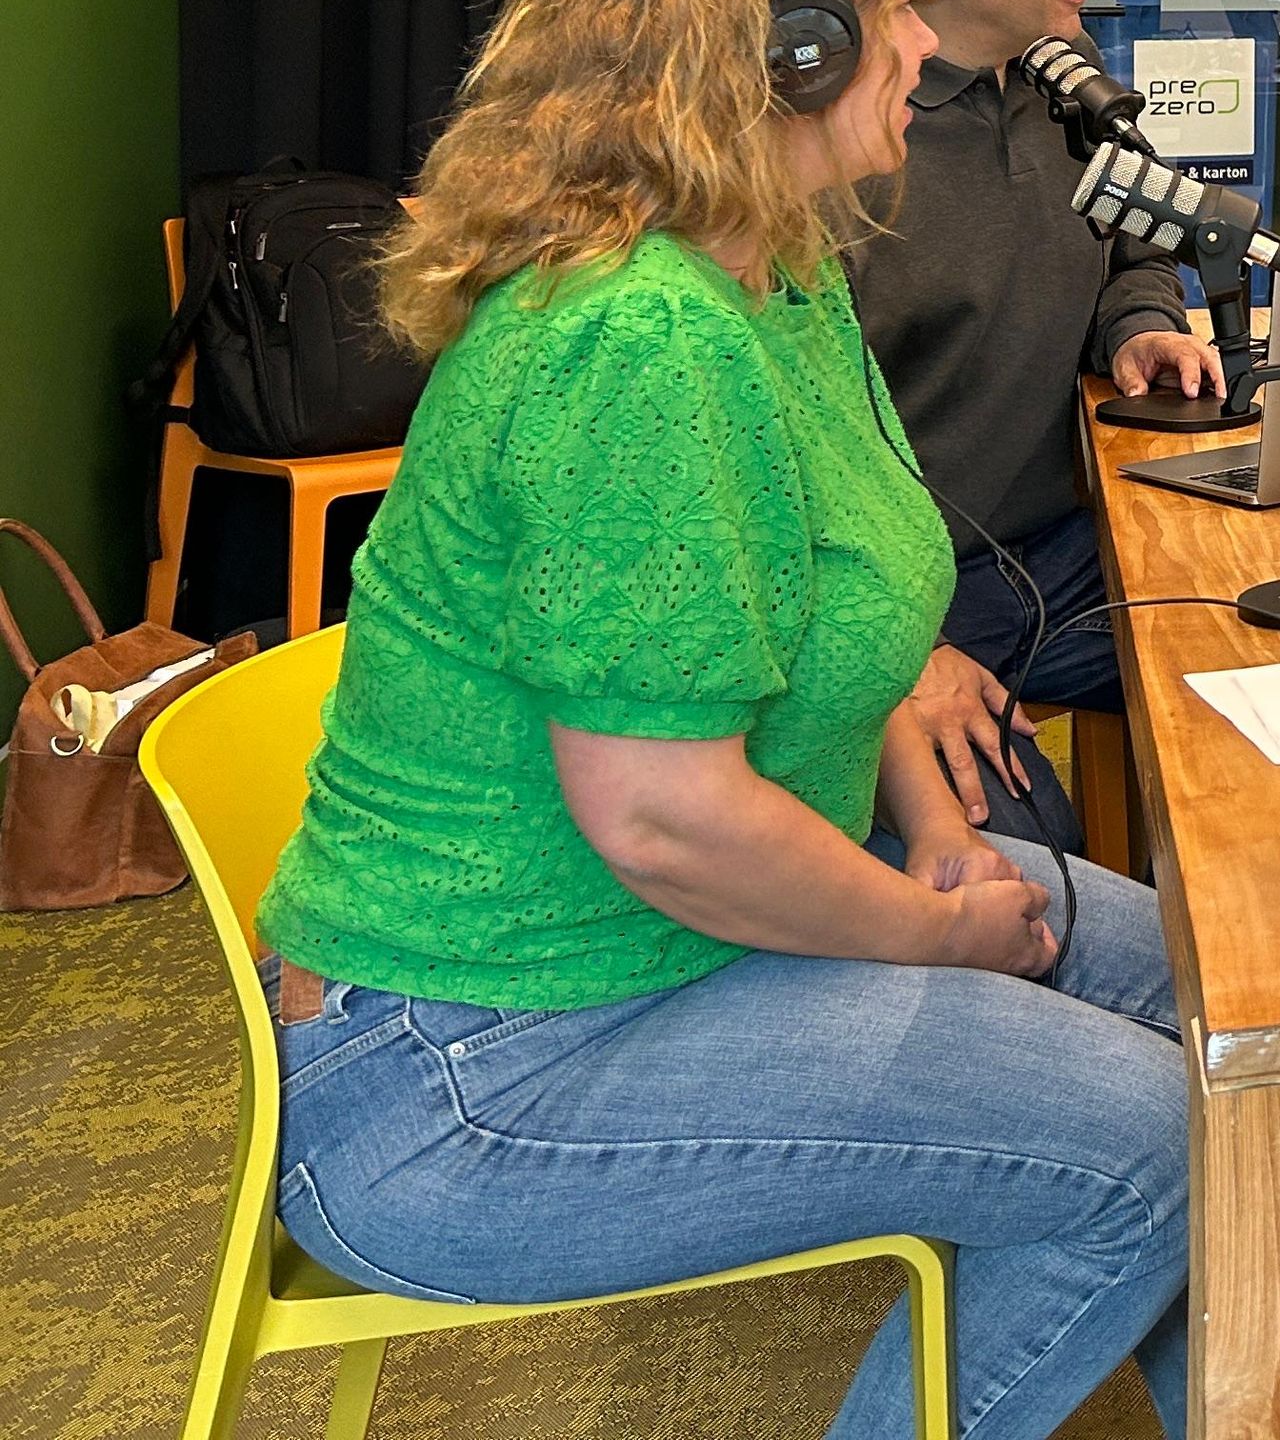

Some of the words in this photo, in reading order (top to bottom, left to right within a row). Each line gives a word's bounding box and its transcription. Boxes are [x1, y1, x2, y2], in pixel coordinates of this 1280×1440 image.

[1149, 80, 1197, 99] pre
[1149, 101, 1215, 115] zero
[1188, 167, 1199, 178] &
[1203, 166, 1248, 179] karton
